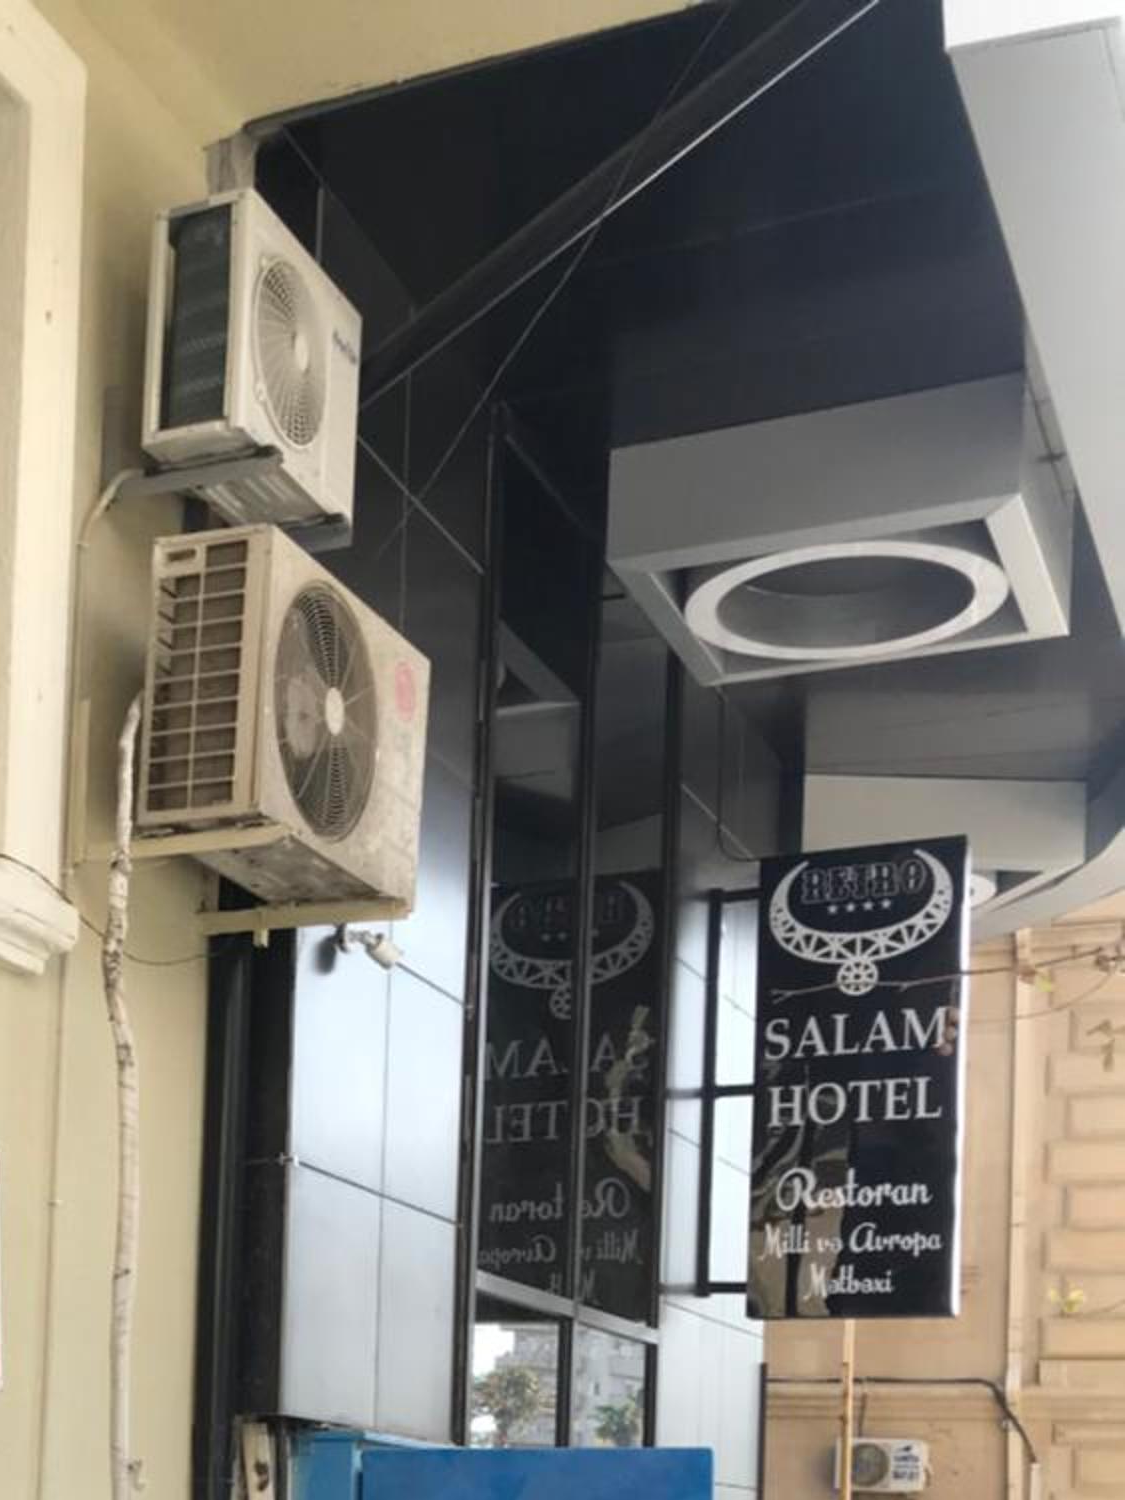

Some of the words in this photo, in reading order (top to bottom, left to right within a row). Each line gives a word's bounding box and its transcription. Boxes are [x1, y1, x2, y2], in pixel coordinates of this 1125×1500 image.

[801, 858, 928, 905] RETRO
[764, 1006, 949, 1060] SALAM
[767, 1076, 942, 1128] HOTEL
[776, 1167, 933, 1211] Restoran
[758, 1222, 811, 1260] Milli
[816, 1236, 844, 1254] və
[849, 1222, 942, 1257] Avropa
[802, 1263, 894, 1301] Mətbəxi
